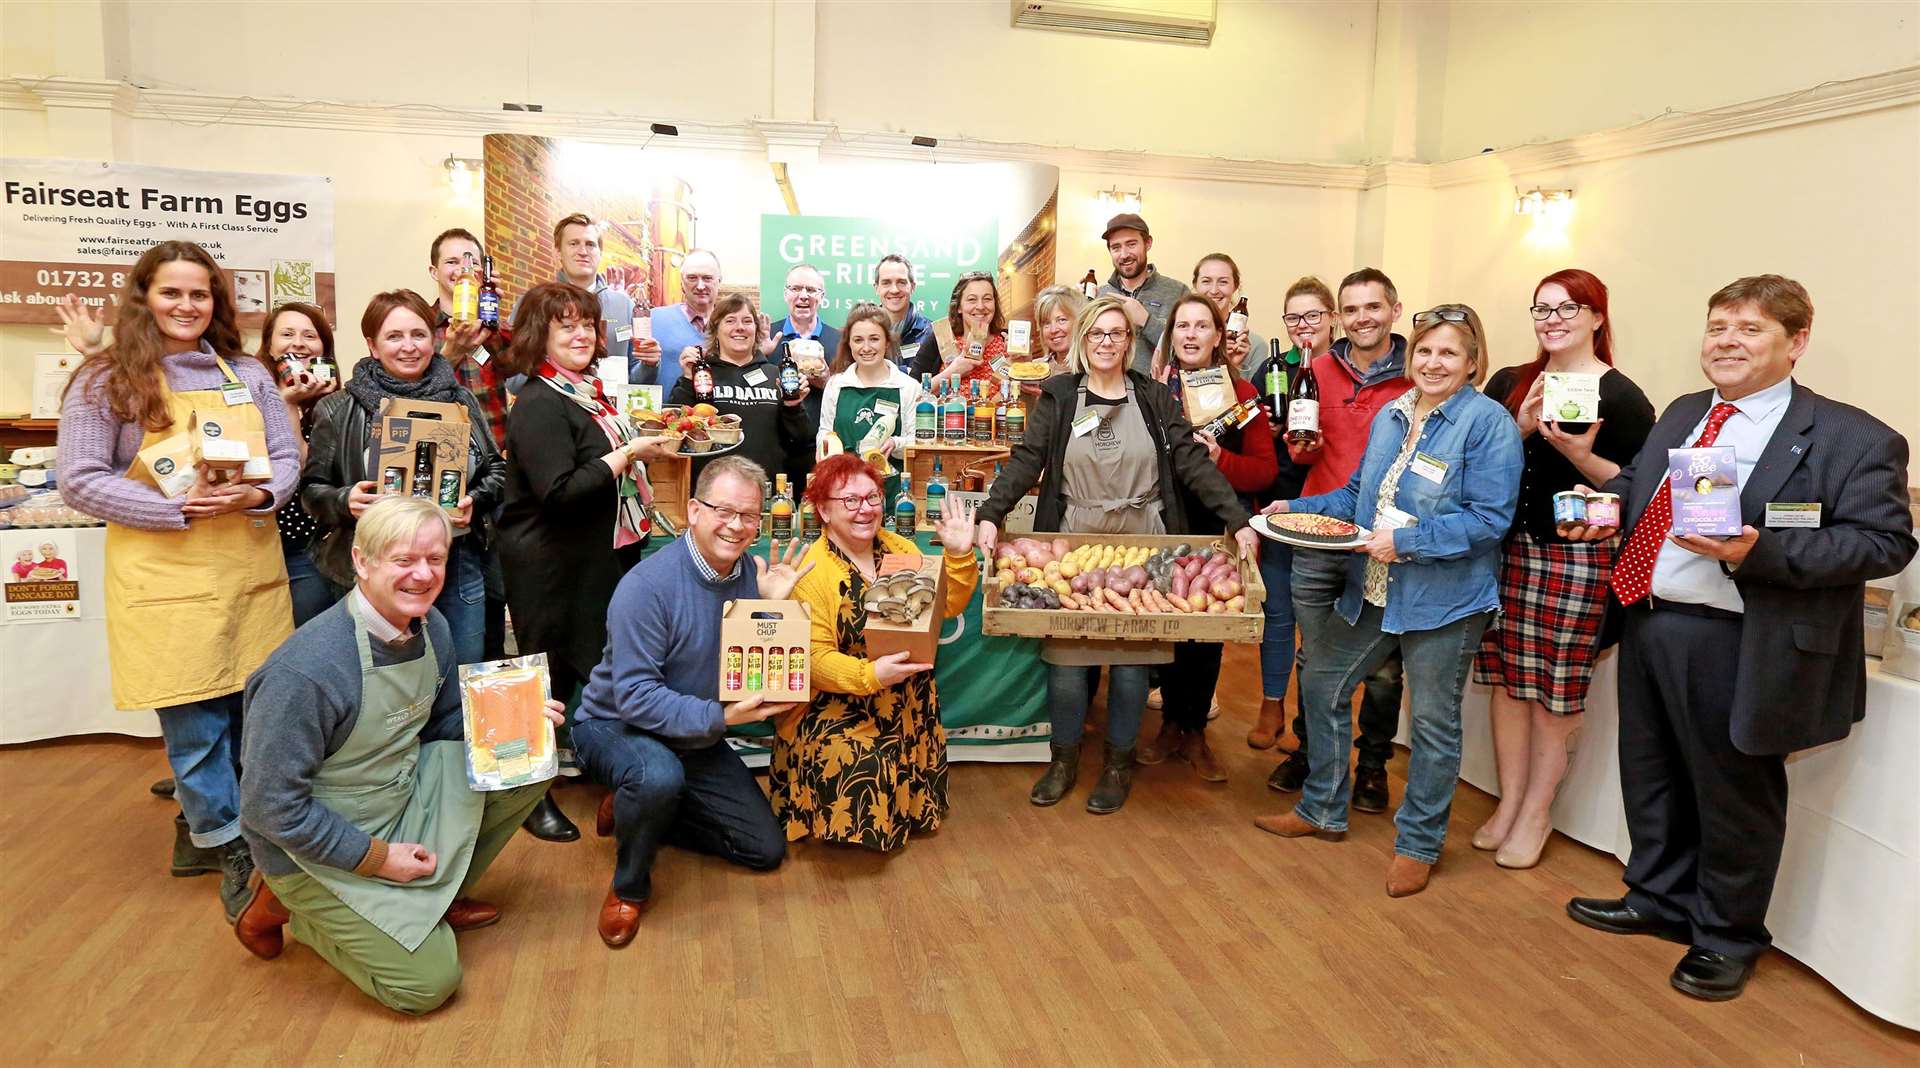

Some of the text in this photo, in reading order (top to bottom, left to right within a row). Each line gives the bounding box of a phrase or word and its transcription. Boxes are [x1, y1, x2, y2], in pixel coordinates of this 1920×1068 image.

[5, 181, 307, 223] Fairseat Farm Eggs
[23, 214, 67, 224] Delivering
[69, 216, 94, 224] Fresh
[96, 217, 131, 227] Quality
[133, 219, 156, 228] Eggs
[166, 220, 188, 228] With
[199, 222, 220, 231] First
[222, 224, 245, 232] Class
[247, 225, 279, 234] Service
[778, 233, 981, 266] GREENSAND
[36, 270, 106, 288] 01732
[836, 263, 926, 286] RIE
[712, 386, 778, 400] LD DAIRY
[9, 591, 74, 600] PANCAKE DAY
[1115, 618, 1156, 634] FARMS
